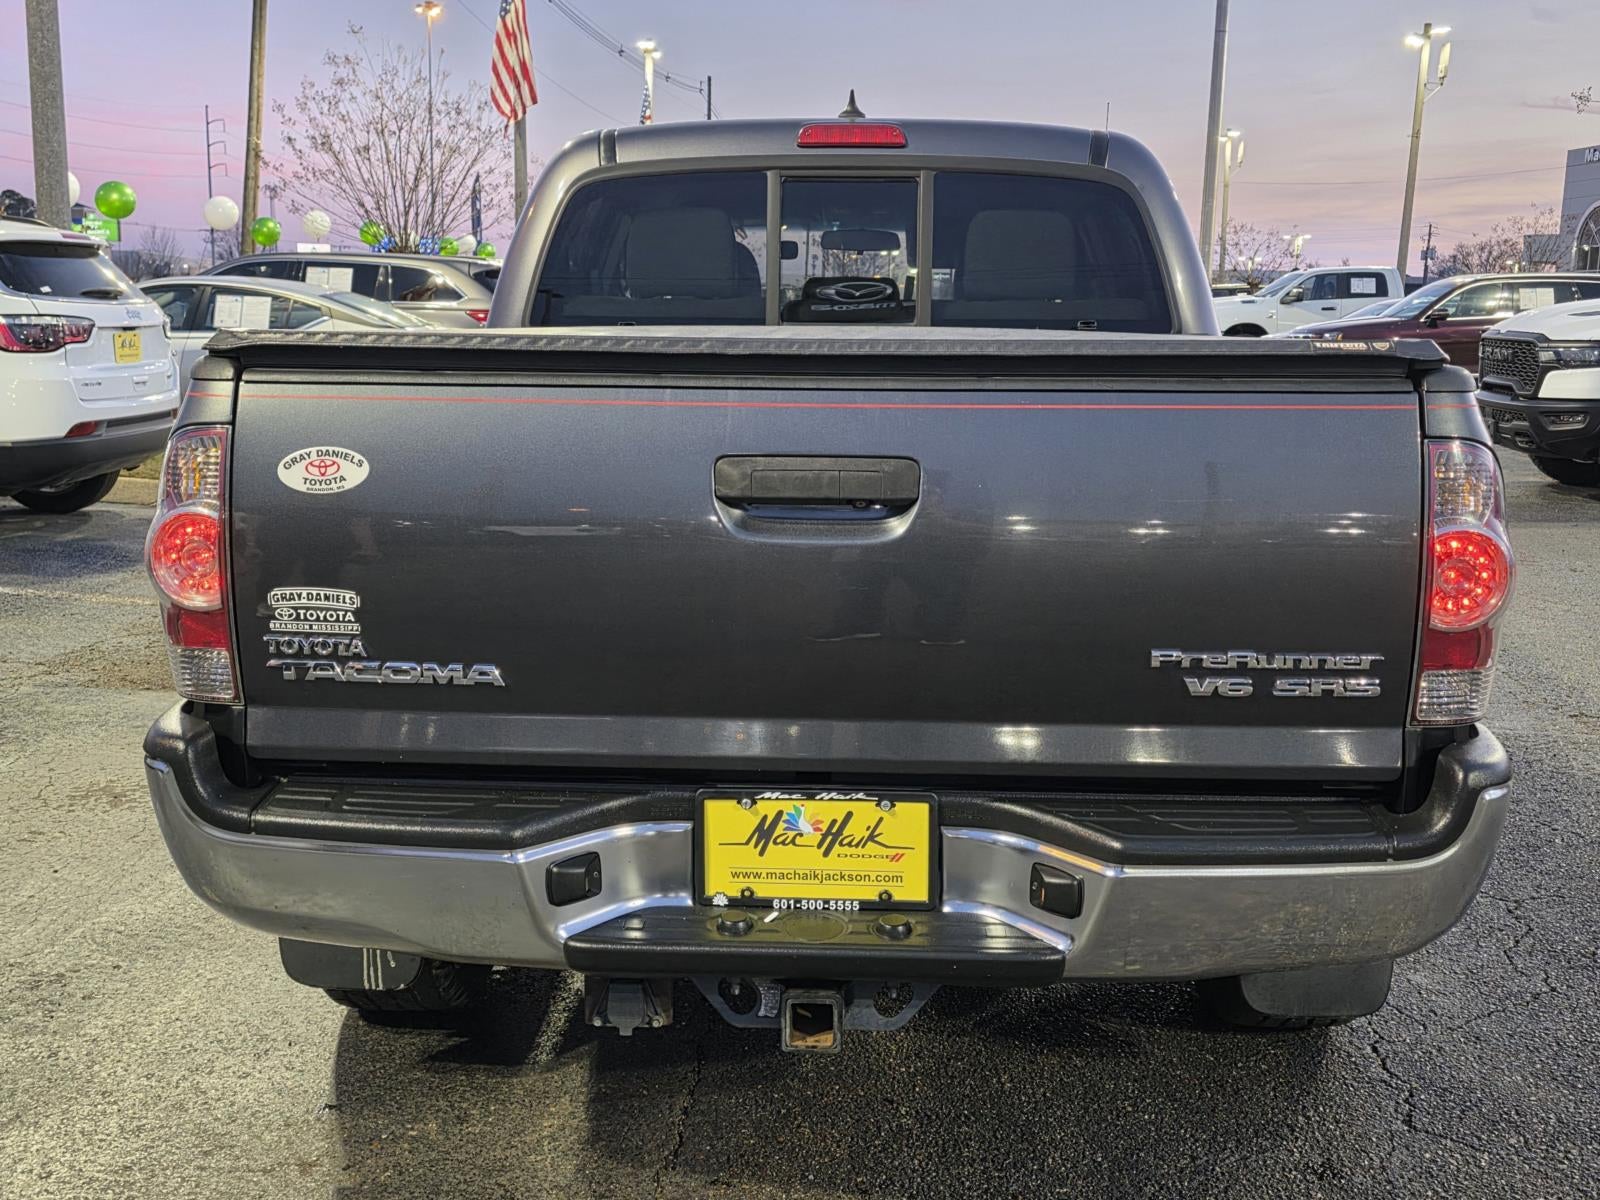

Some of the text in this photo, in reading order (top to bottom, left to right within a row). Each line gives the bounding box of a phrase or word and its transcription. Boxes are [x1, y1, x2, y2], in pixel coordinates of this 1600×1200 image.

[1585, 148, 1600, 163] Ma
[283, 449, 365, 470] GRAY DANIELS
[302, 475, 347, 486] TOYOTA
[297, 609, 355, 622] TOYOTA
[269, 622, 361, 632] BRANDON MISSISSIPPI
[263, 635, 368, 657] TOYOTA
[266, 658, 506, 687] TACOMA
[1183, 676, 1381, 697] V6 SR5
[754, 791, 879, 800] Mac Haik
[718, 809, 915, 859] Mac Haik
[730, 869, 904, 884] www.machaikjackson.com
[773, 899, 860, 911] 601-500-5555
